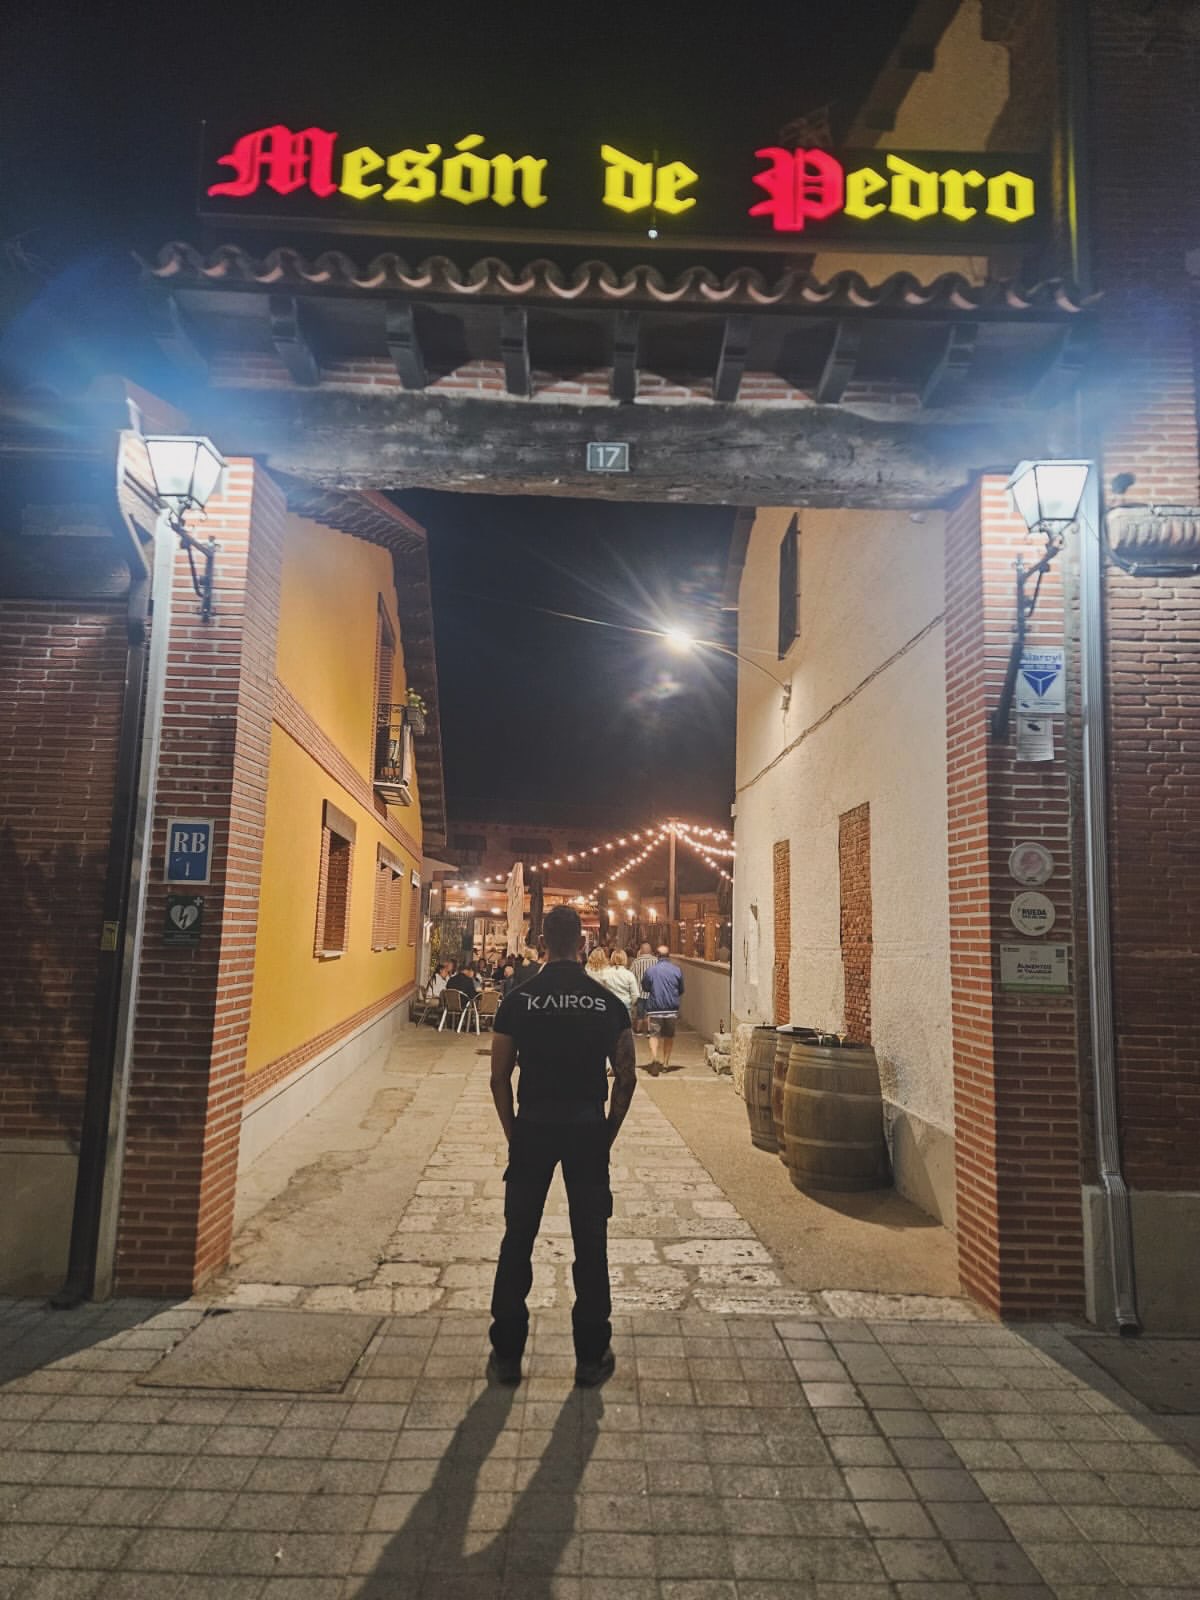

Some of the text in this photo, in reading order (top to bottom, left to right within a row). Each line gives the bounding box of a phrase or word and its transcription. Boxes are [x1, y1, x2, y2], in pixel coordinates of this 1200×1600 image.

[207, 125, 1036, 231] Mesón de Pedro
[597, 446, 621, 468] 17
[173, 831, 207, 854] RB
[520, 992, 607, 1011] KAIROS
